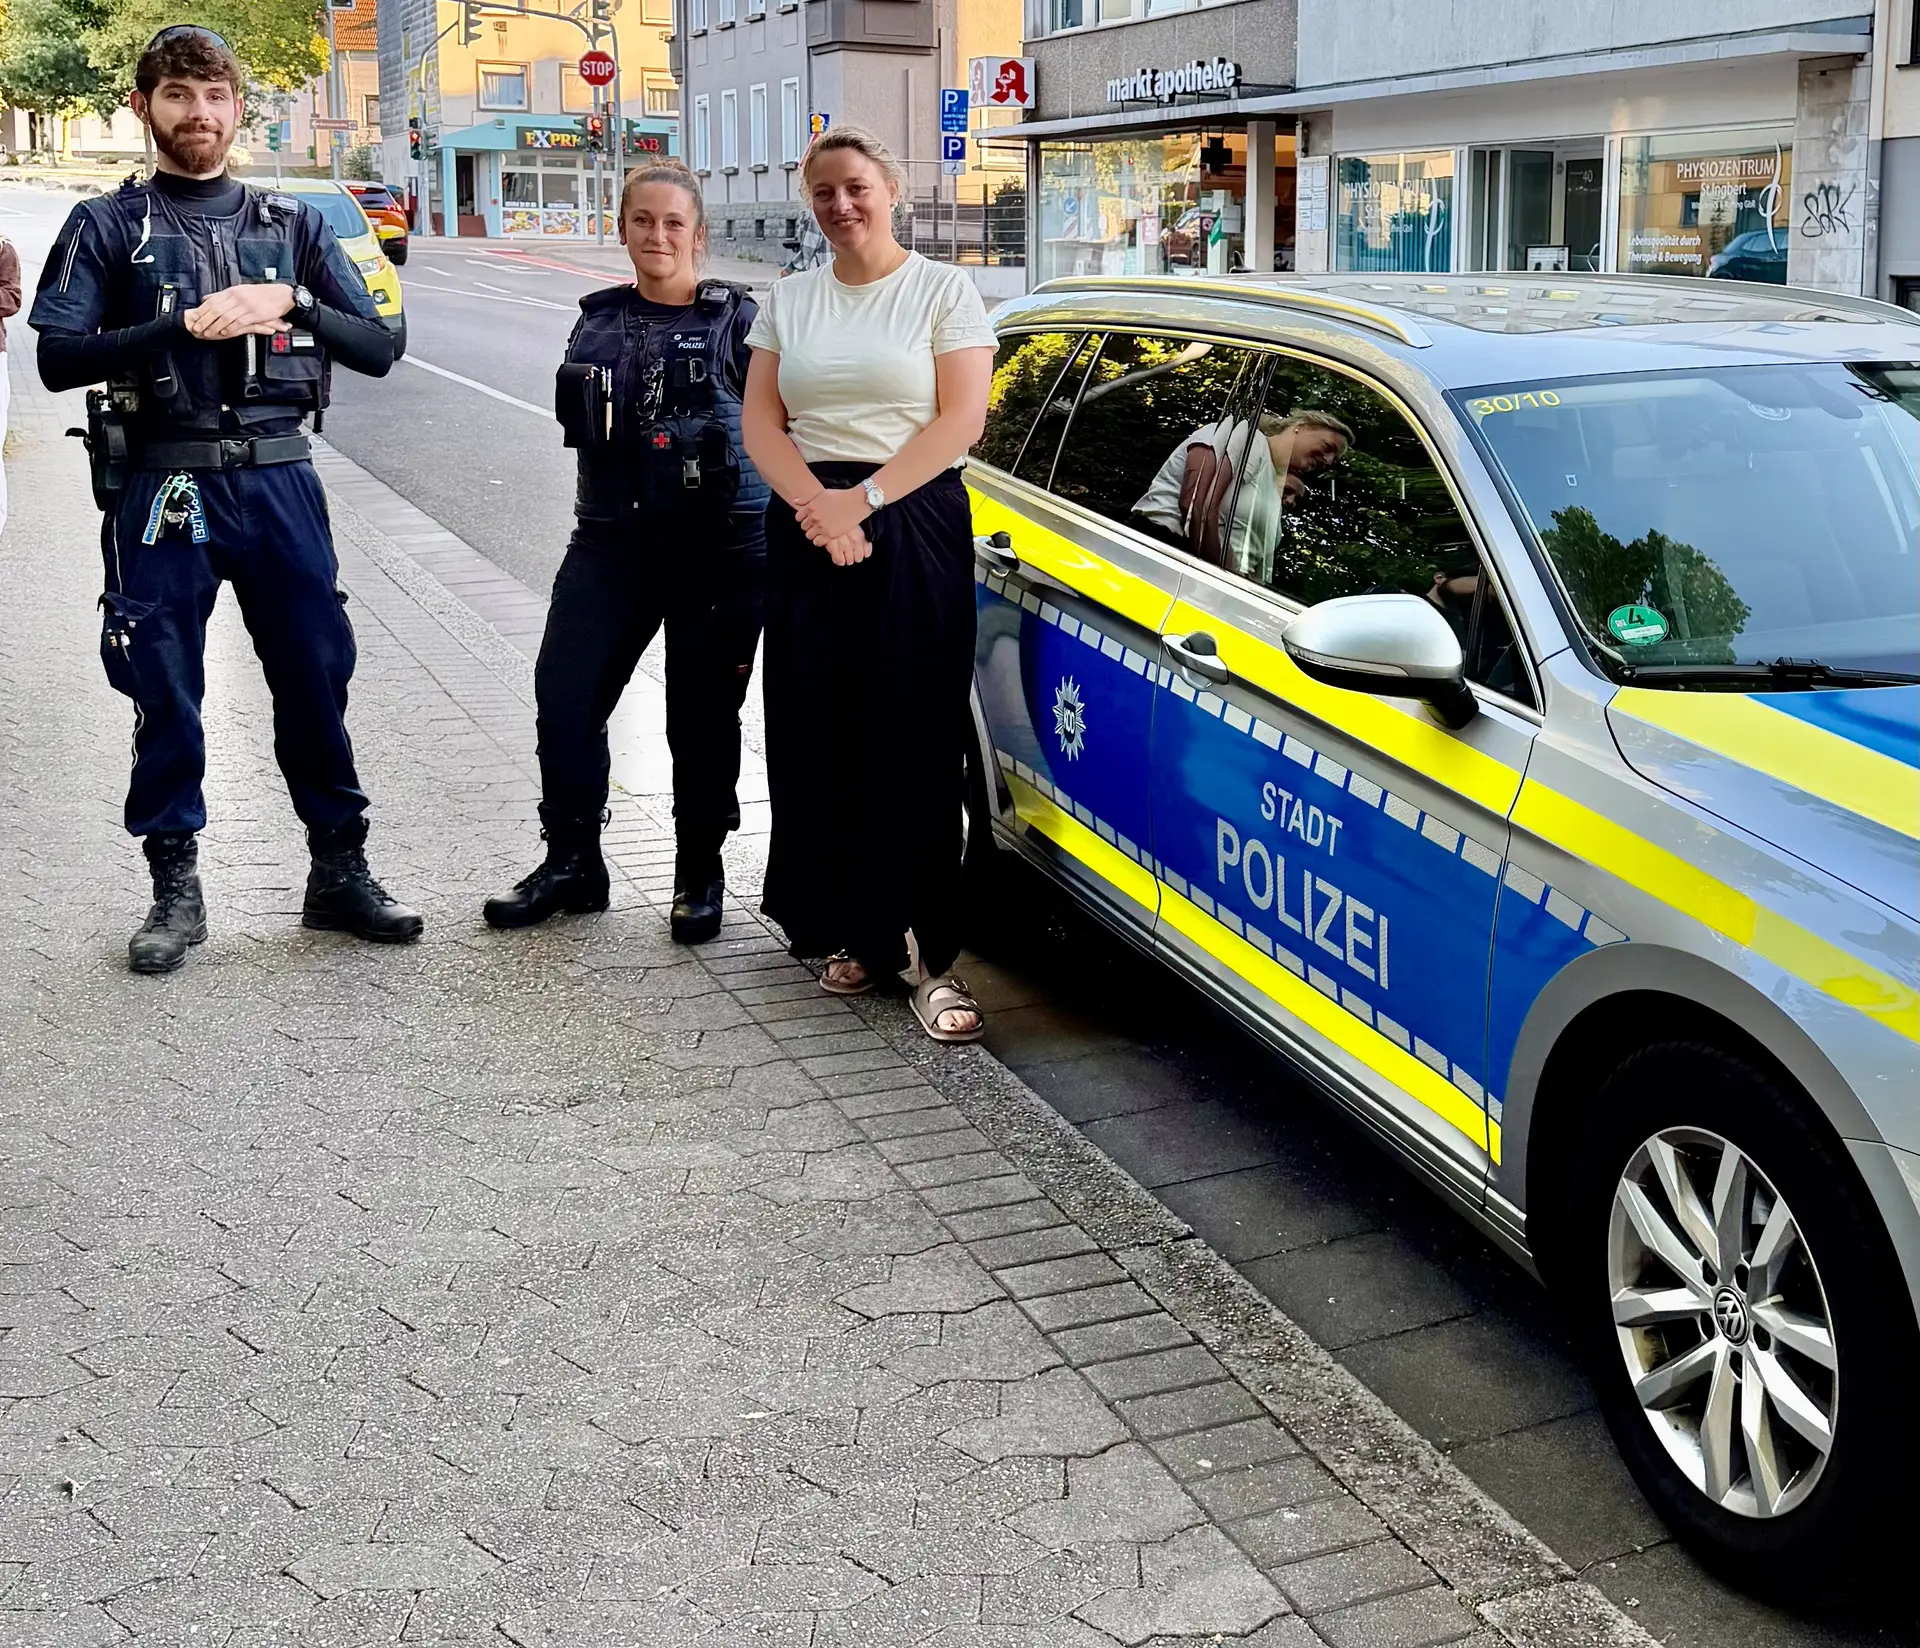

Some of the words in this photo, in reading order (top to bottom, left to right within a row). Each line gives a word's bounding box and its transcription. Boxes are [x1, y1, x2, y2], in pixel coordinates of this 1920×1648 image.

[582, 61, 613, 76] STOP
[1107, 68, 1153, 102] markt
[1154, 56, 1236, 103] apotheke
[944, 91, 959, 112] P
[948, 139, 962, 157] P
[1582, 169, 1594, 183] 40
[1676, 157, 1776, 179] PHYSIOZENTRUM
[1680, 234, 1702, 246] durch
[1628, 250, 1658, 264] Therapie
[1658, 251, 1664, 262] &
[1665, 251, 1703, 265] Bewegung
[1473, 391, 1561, 415] 30/10
[189, 499, 207, 539] OLIZEI
[1628, 608, 1645, 625] 4
[1260, 781, 1343, 857] STADT
[1216, 817, 1389, 990] POLIZEI
